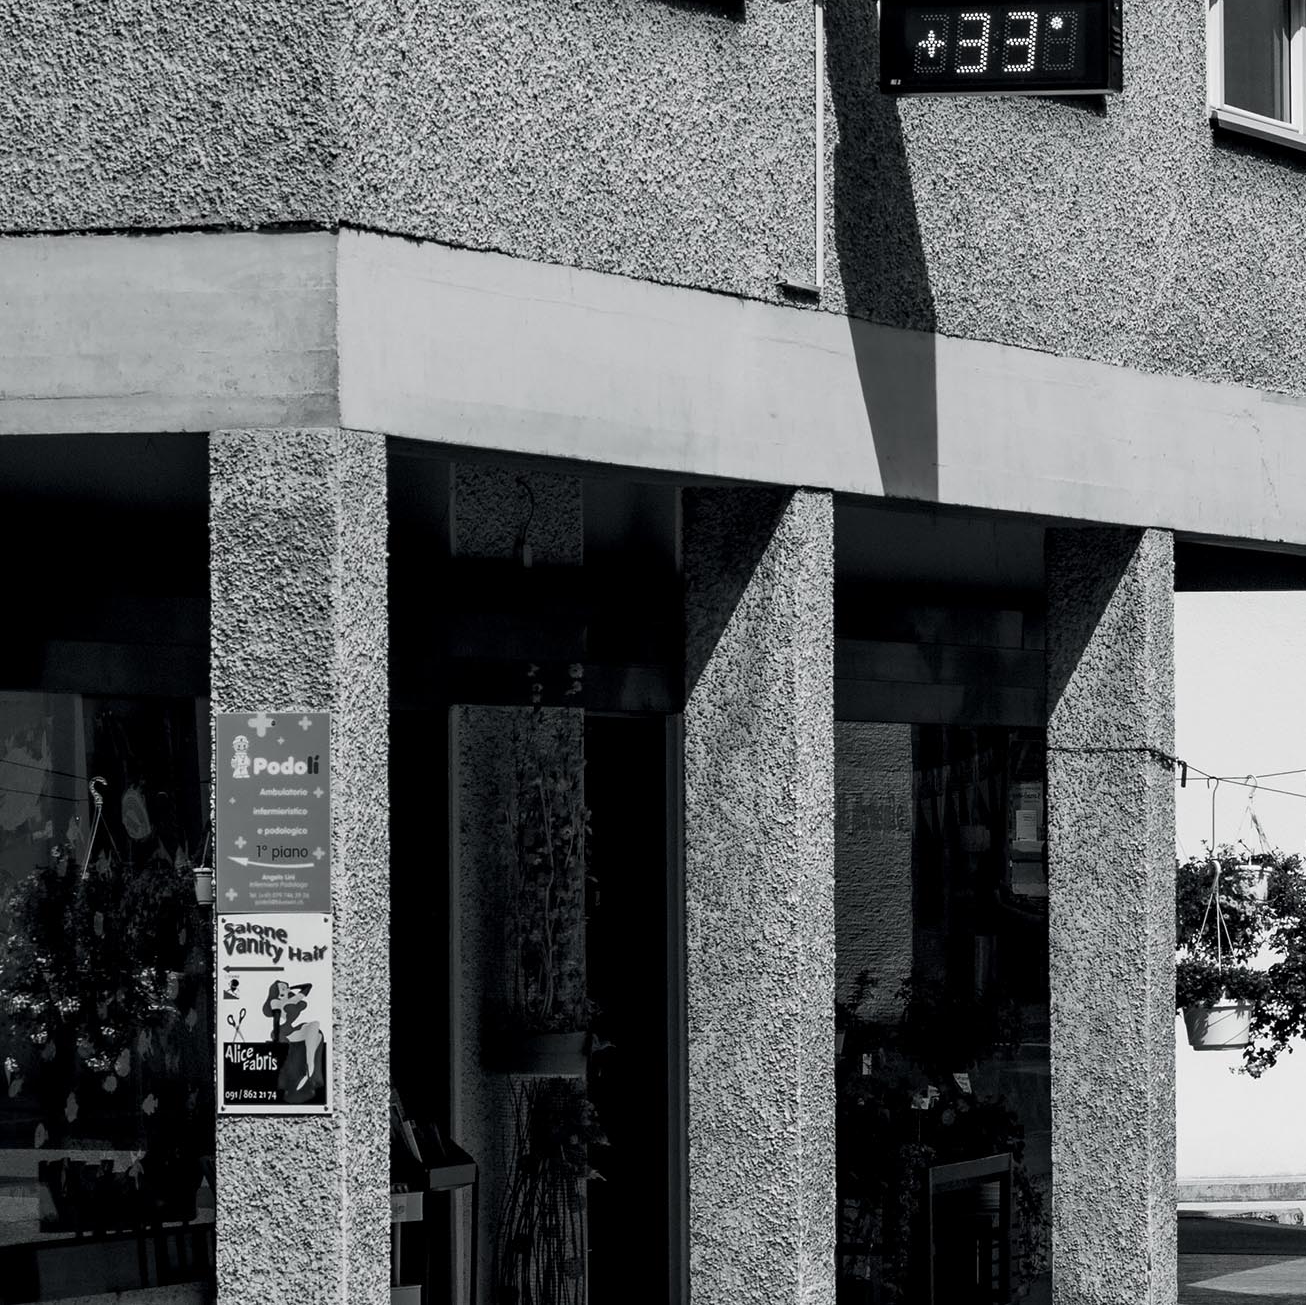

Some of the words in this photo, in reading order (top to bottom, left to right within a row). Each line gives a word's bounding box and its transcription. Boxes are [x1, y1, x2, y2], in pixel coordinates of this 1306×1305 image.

[260, 788, 308, 796] Ambulatorio
[253, 806, 308, 816] infermieristico
[264, 826, 308, 836] podologico
[272, 846, 308, 861] piano
[223, 922, 288, 945] Salone
[223, 934, 284, 964] Vanity
[288, 945, 327, 963] Hair
[225, 1044, 254, 1063] Alice
[243, 1051, 278, 1071] Fabris
[259, 1091, 267, 1099] 21
[267, 1091, 277, 1100] 74
